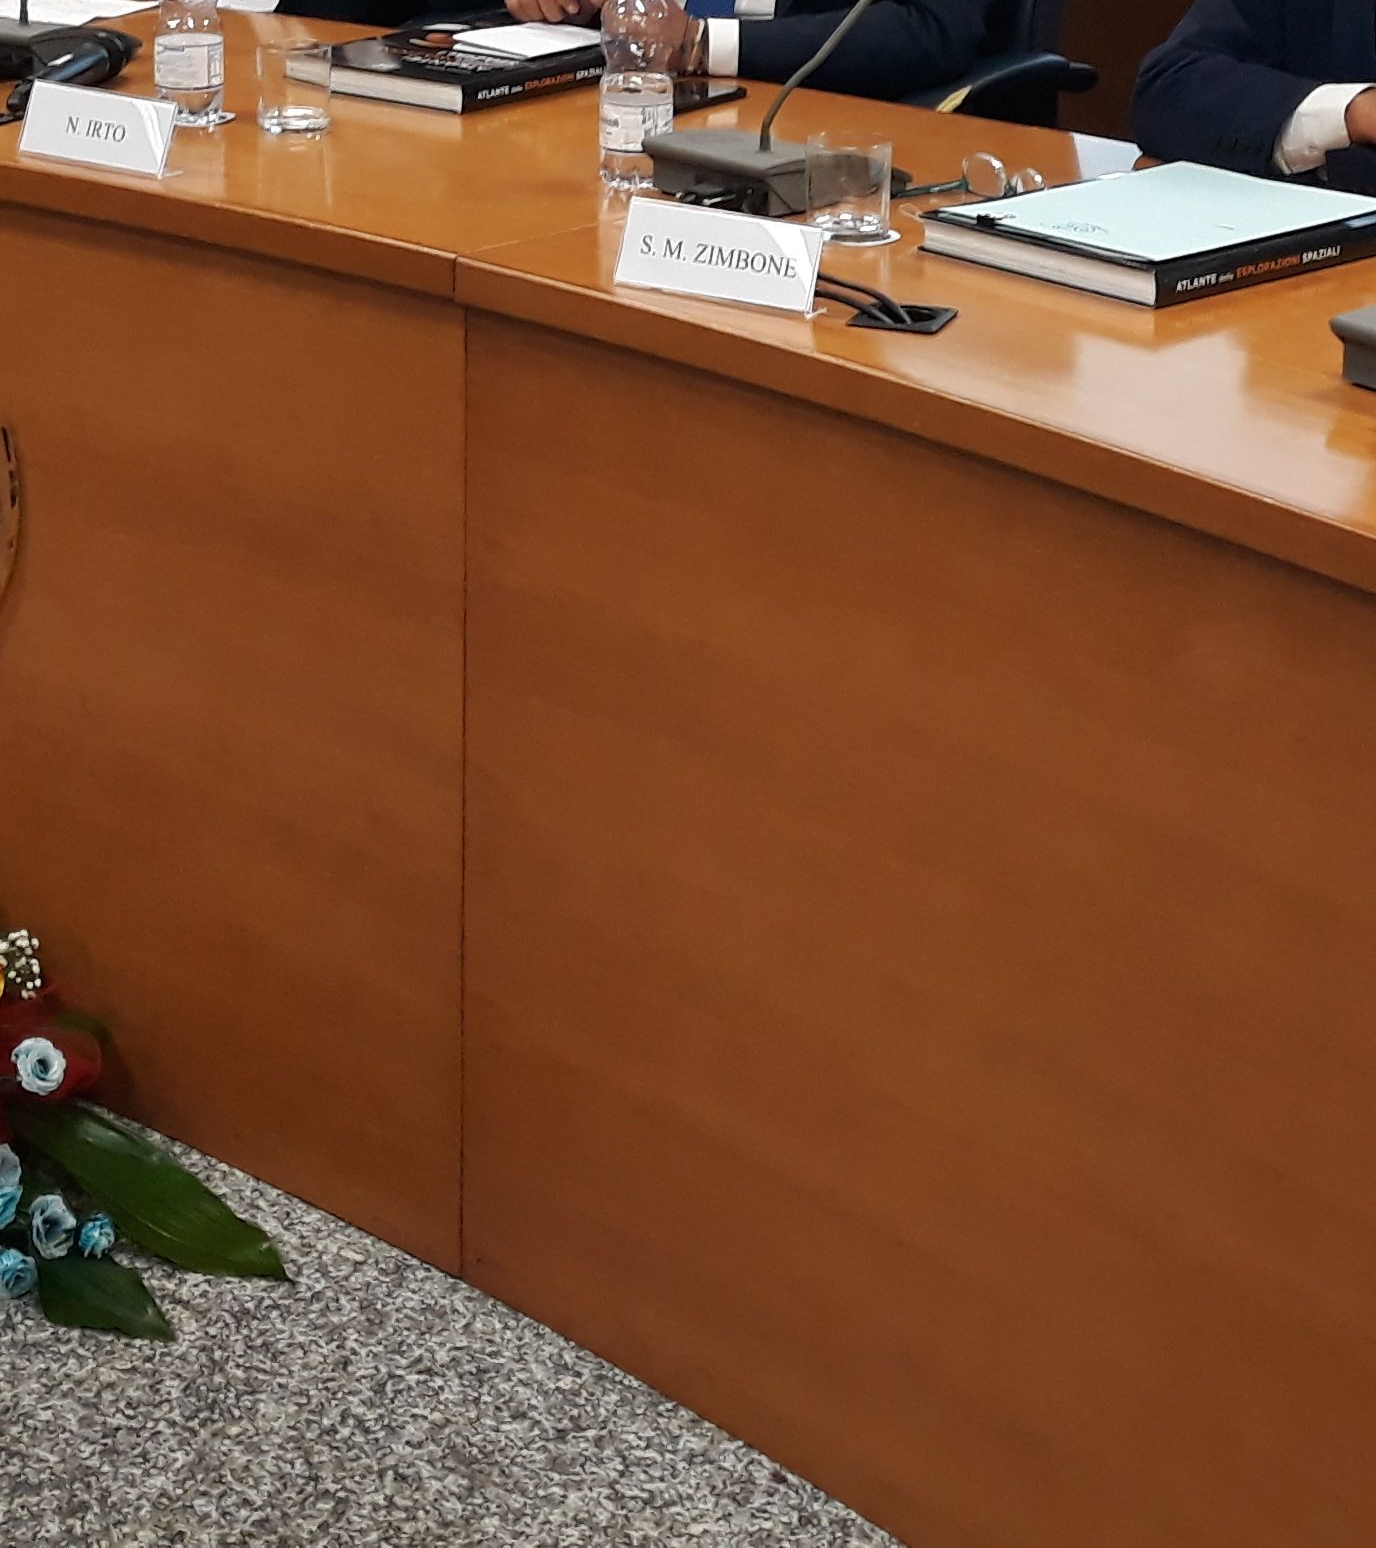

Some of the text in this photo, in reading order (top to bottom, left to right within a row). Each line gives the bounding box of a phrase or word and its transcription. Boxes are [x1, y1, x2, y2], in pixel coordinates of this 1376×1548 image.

[66, 115, 126, 142] N. IRTO
[639, 234, 798, 280] S. M. ZIMBONE
[1176, 272, 1217, 293] ATLANTE
[1302, 245, 1341, 265] SPAZIALI
